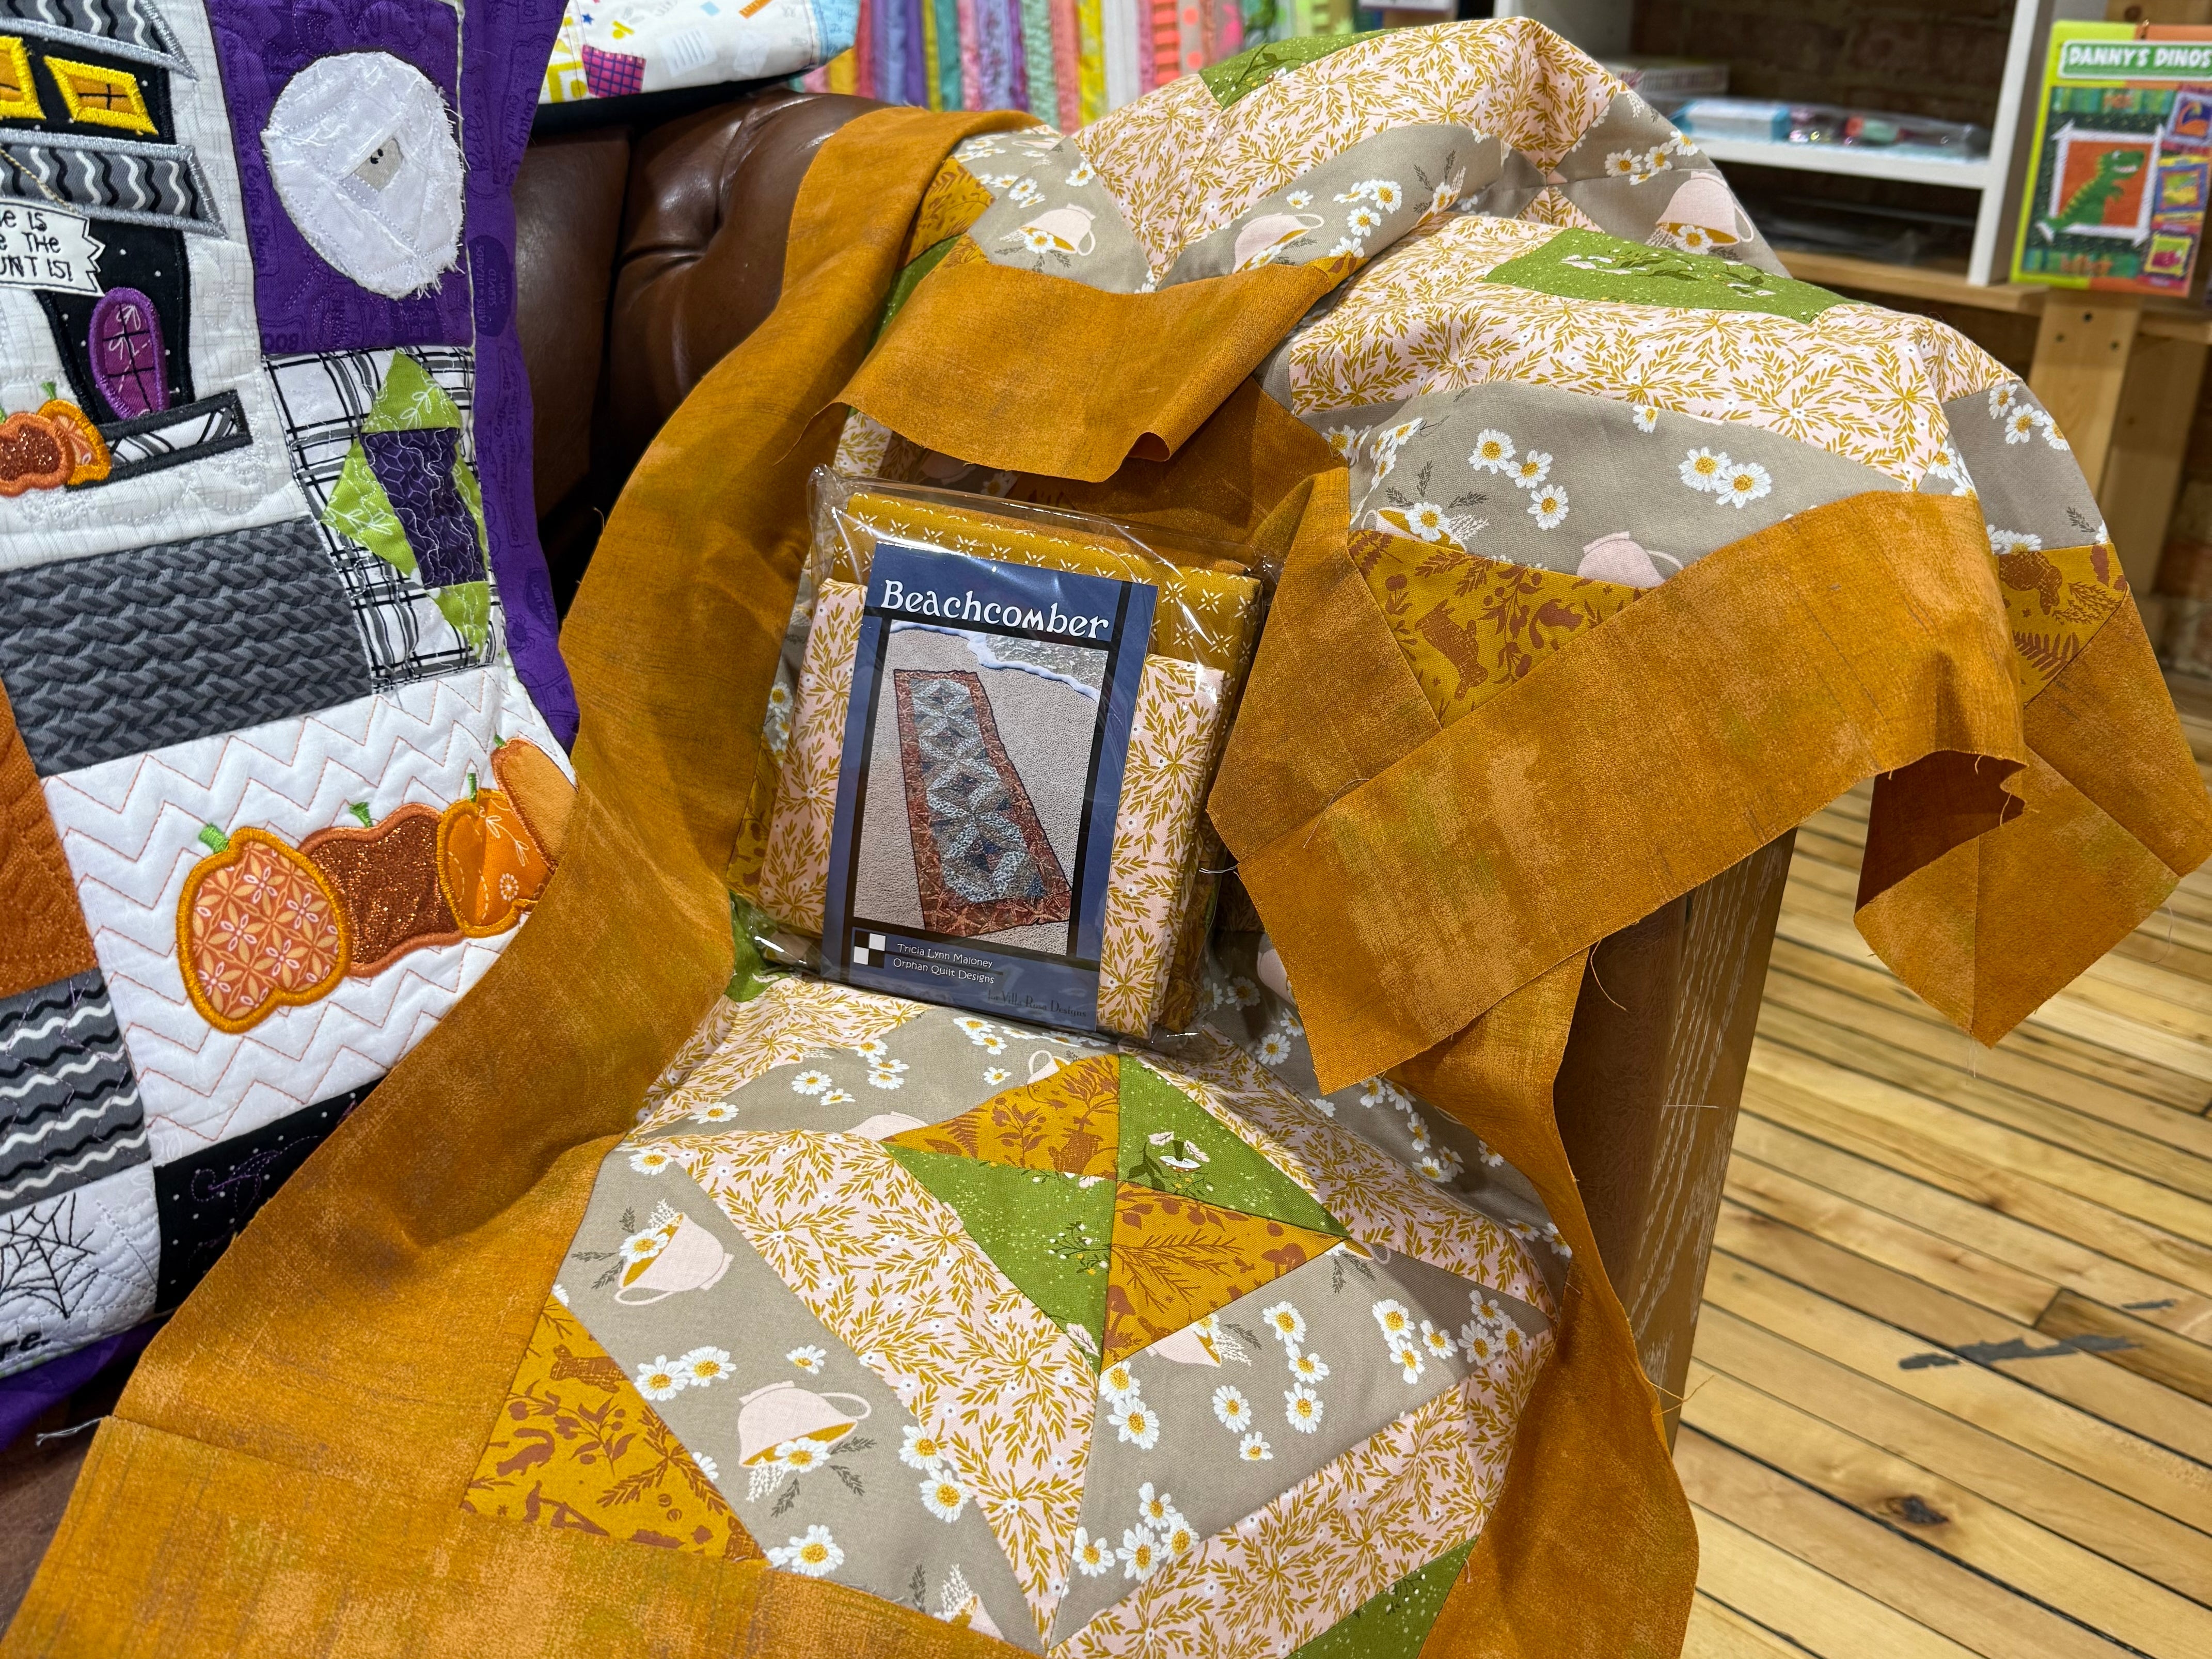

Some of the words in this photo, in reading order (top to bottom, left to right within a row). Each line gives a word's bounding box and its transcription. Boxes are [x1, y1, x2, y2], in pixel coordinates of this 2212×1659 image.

[880, 579, 1109, 639] Beachcomber
[897, 943, 925, 957] Tricia
[927, 948, 951, 961] Lynn
[953, 953, 994, 969] Maloney
[893, 958, 928, 974] Orphan
[931, 964, 955, 977] Quilt
[958, 969, 995, 985] Designs
[1001, 990, 1023, 1006] Villa
[1050, 1000, 1087, 1018] Designs
